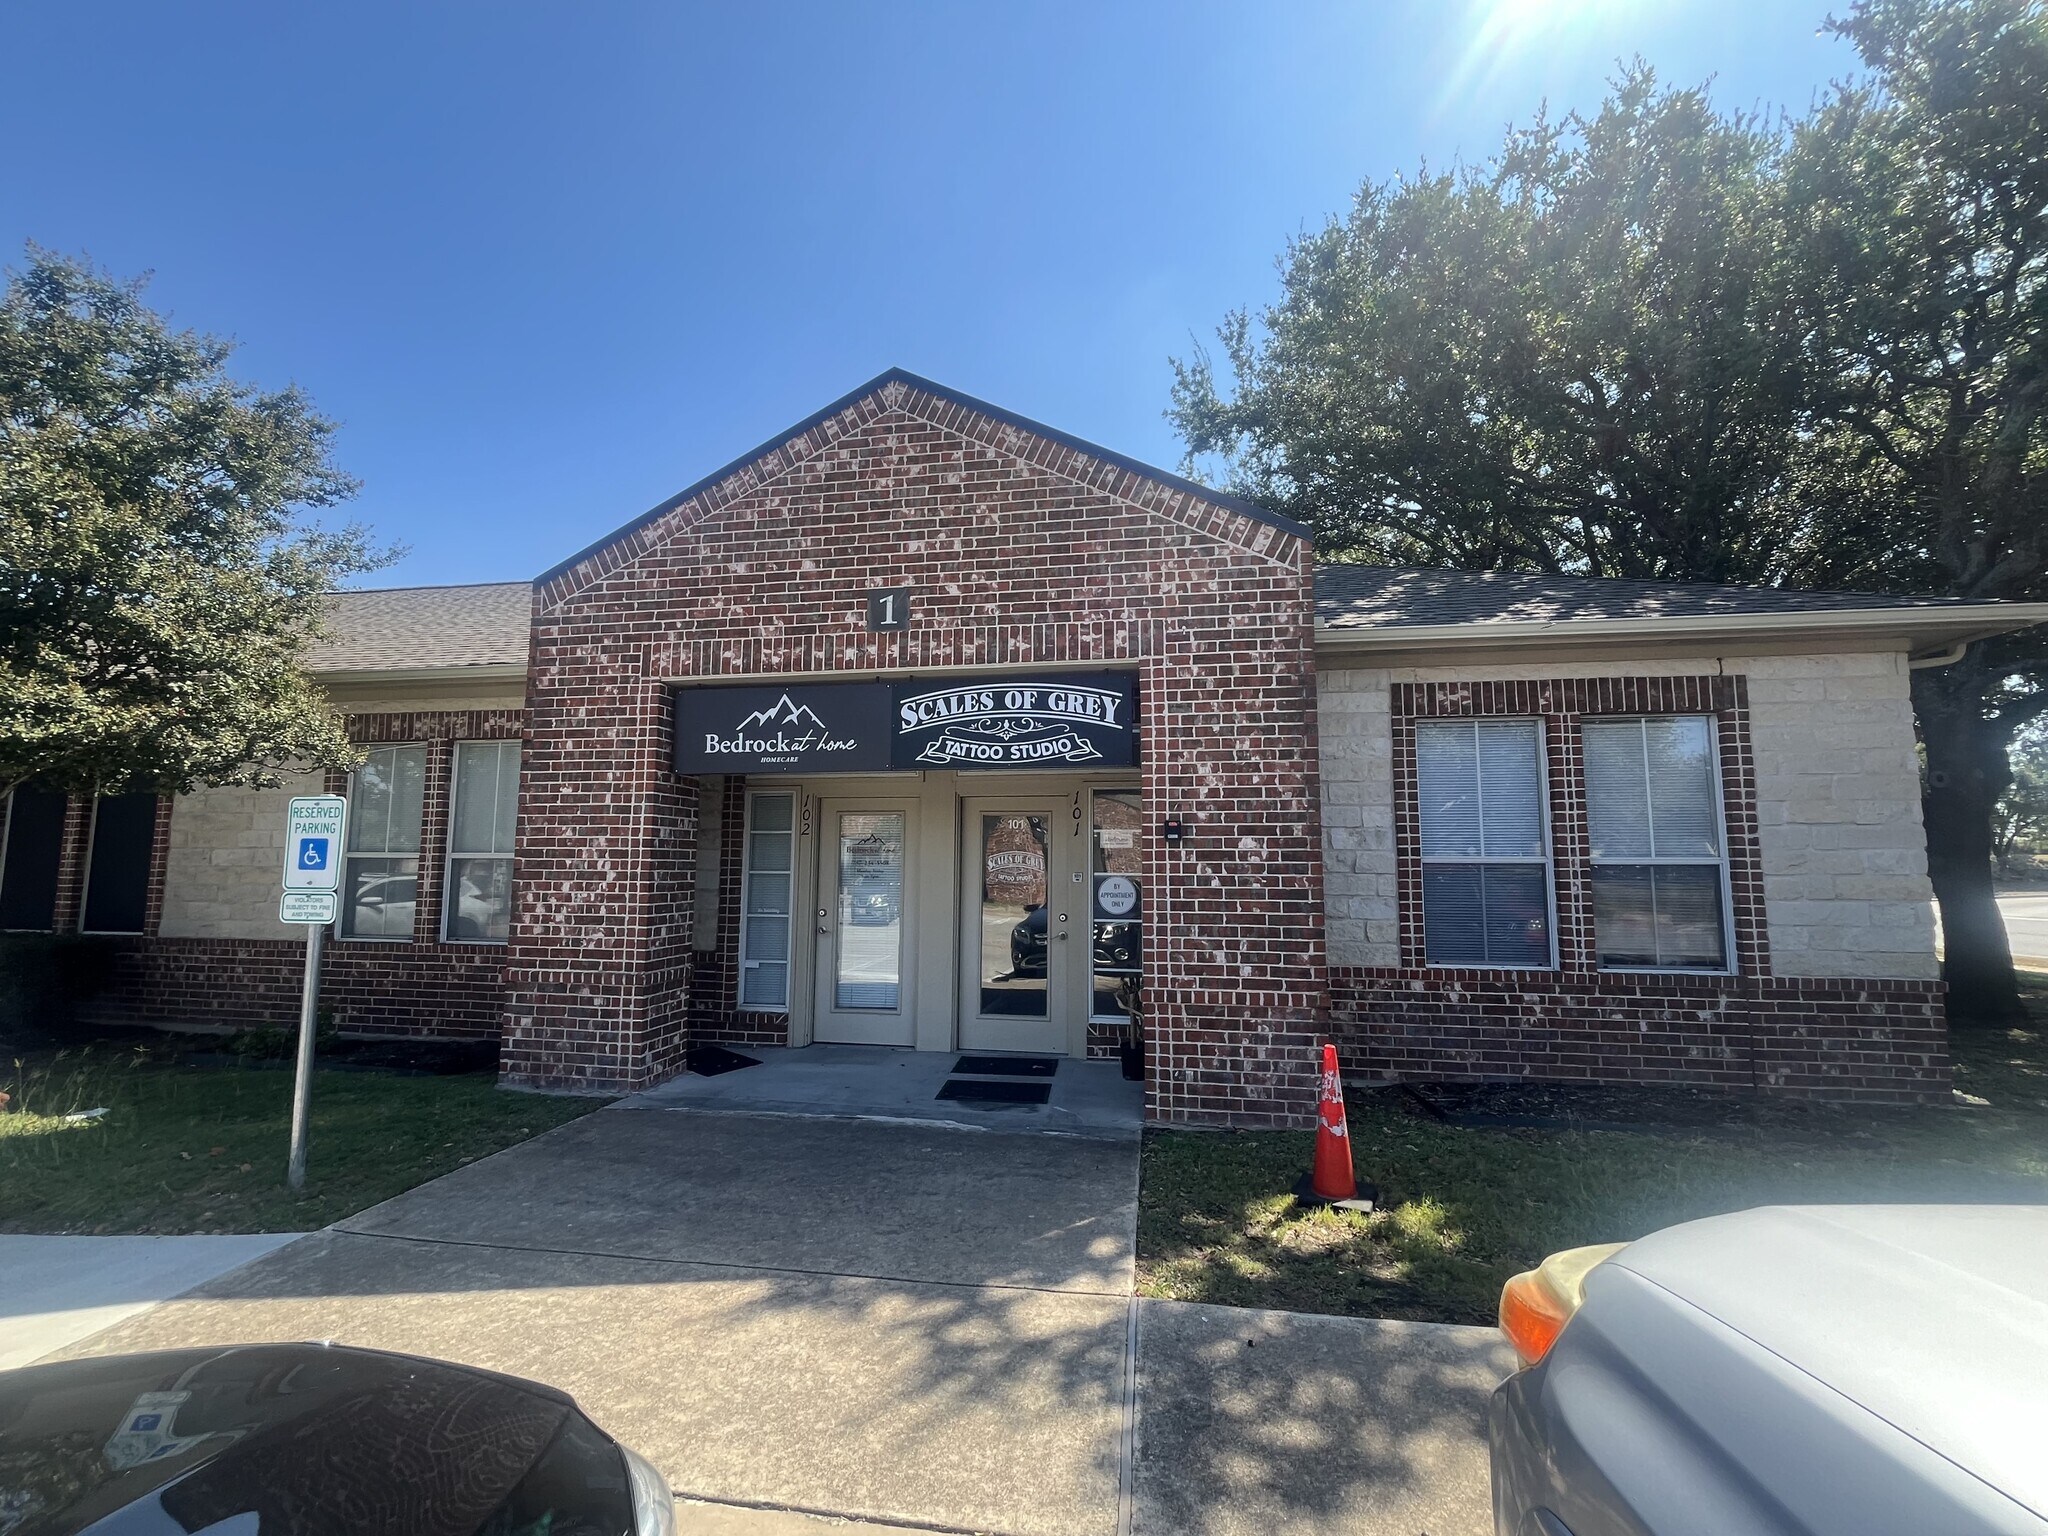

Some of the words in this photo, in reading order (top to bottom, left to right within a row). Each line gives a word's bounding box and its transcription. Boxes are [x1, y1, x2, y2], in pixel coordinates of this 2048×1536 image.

[879, 594, 898, 625] 1
[900, 691, 994, 729] SCALES
[1004, 690, 1037, 709] OF
[1048, 691, 1121, 724] GREY
[704, 731, 791, 754] Bedrock
[791, 729, 817, 751] at
[816, 731, 858, 751] home
[945, 740, 1003, 759] TATTOO
[1010, 738, 1072, 759] STUDIO
[293, 807, 341, 818] RESERVED
[801, 794, 810, 835] 102
[1007, 819, 1024, 829] 101
[1072, 790, 1081, 837] 101
[294, 822, 336, 834] PARKING
